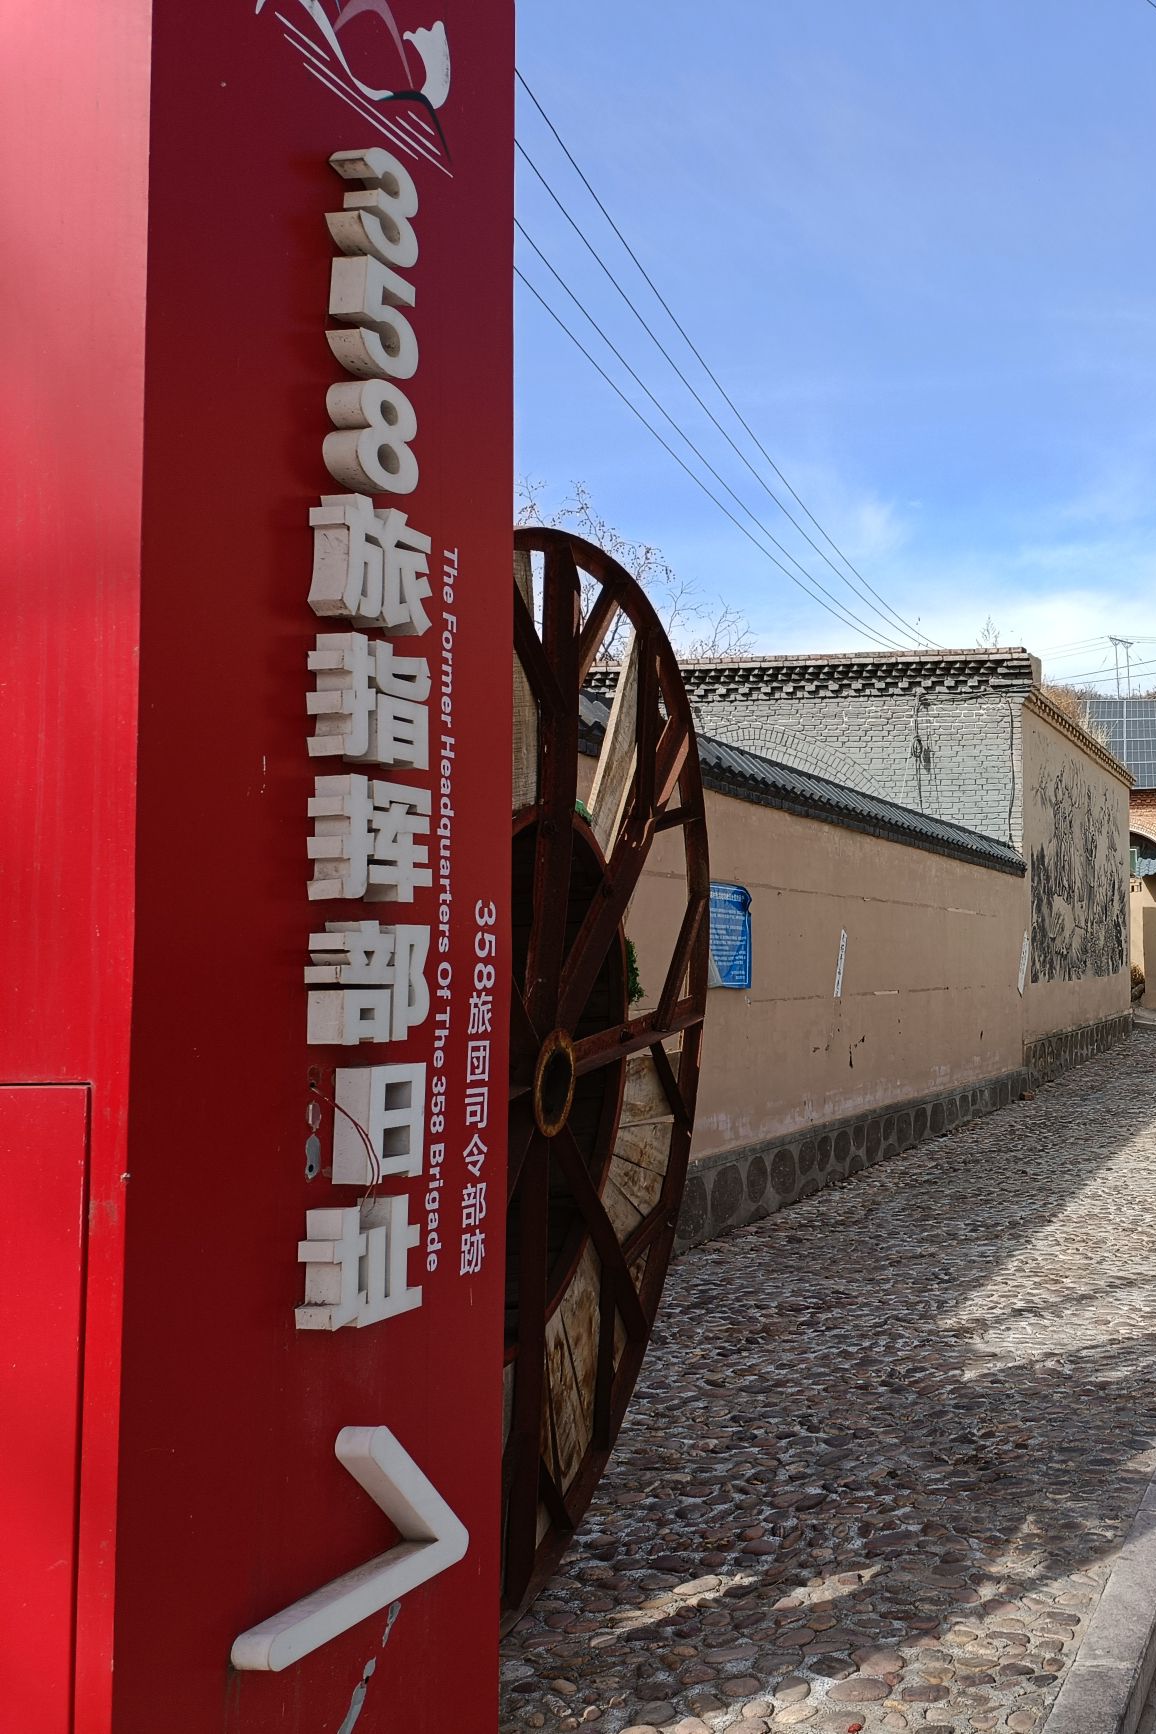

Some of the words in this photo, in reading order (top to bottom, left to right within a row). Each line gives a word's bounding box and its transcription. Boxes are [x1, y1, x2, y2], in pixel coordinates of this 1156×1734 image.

[443, 547, 458, 604] The
[441, 611, 457, 728] Former
[437, 735, 455, 954] Headquarters
[437, 961, 452, 1000] Of
[433, 1012, 449, 1069] The
[430, 1076, 445, 1134] 358
[425, 1143, 445, 1272] Brigade
